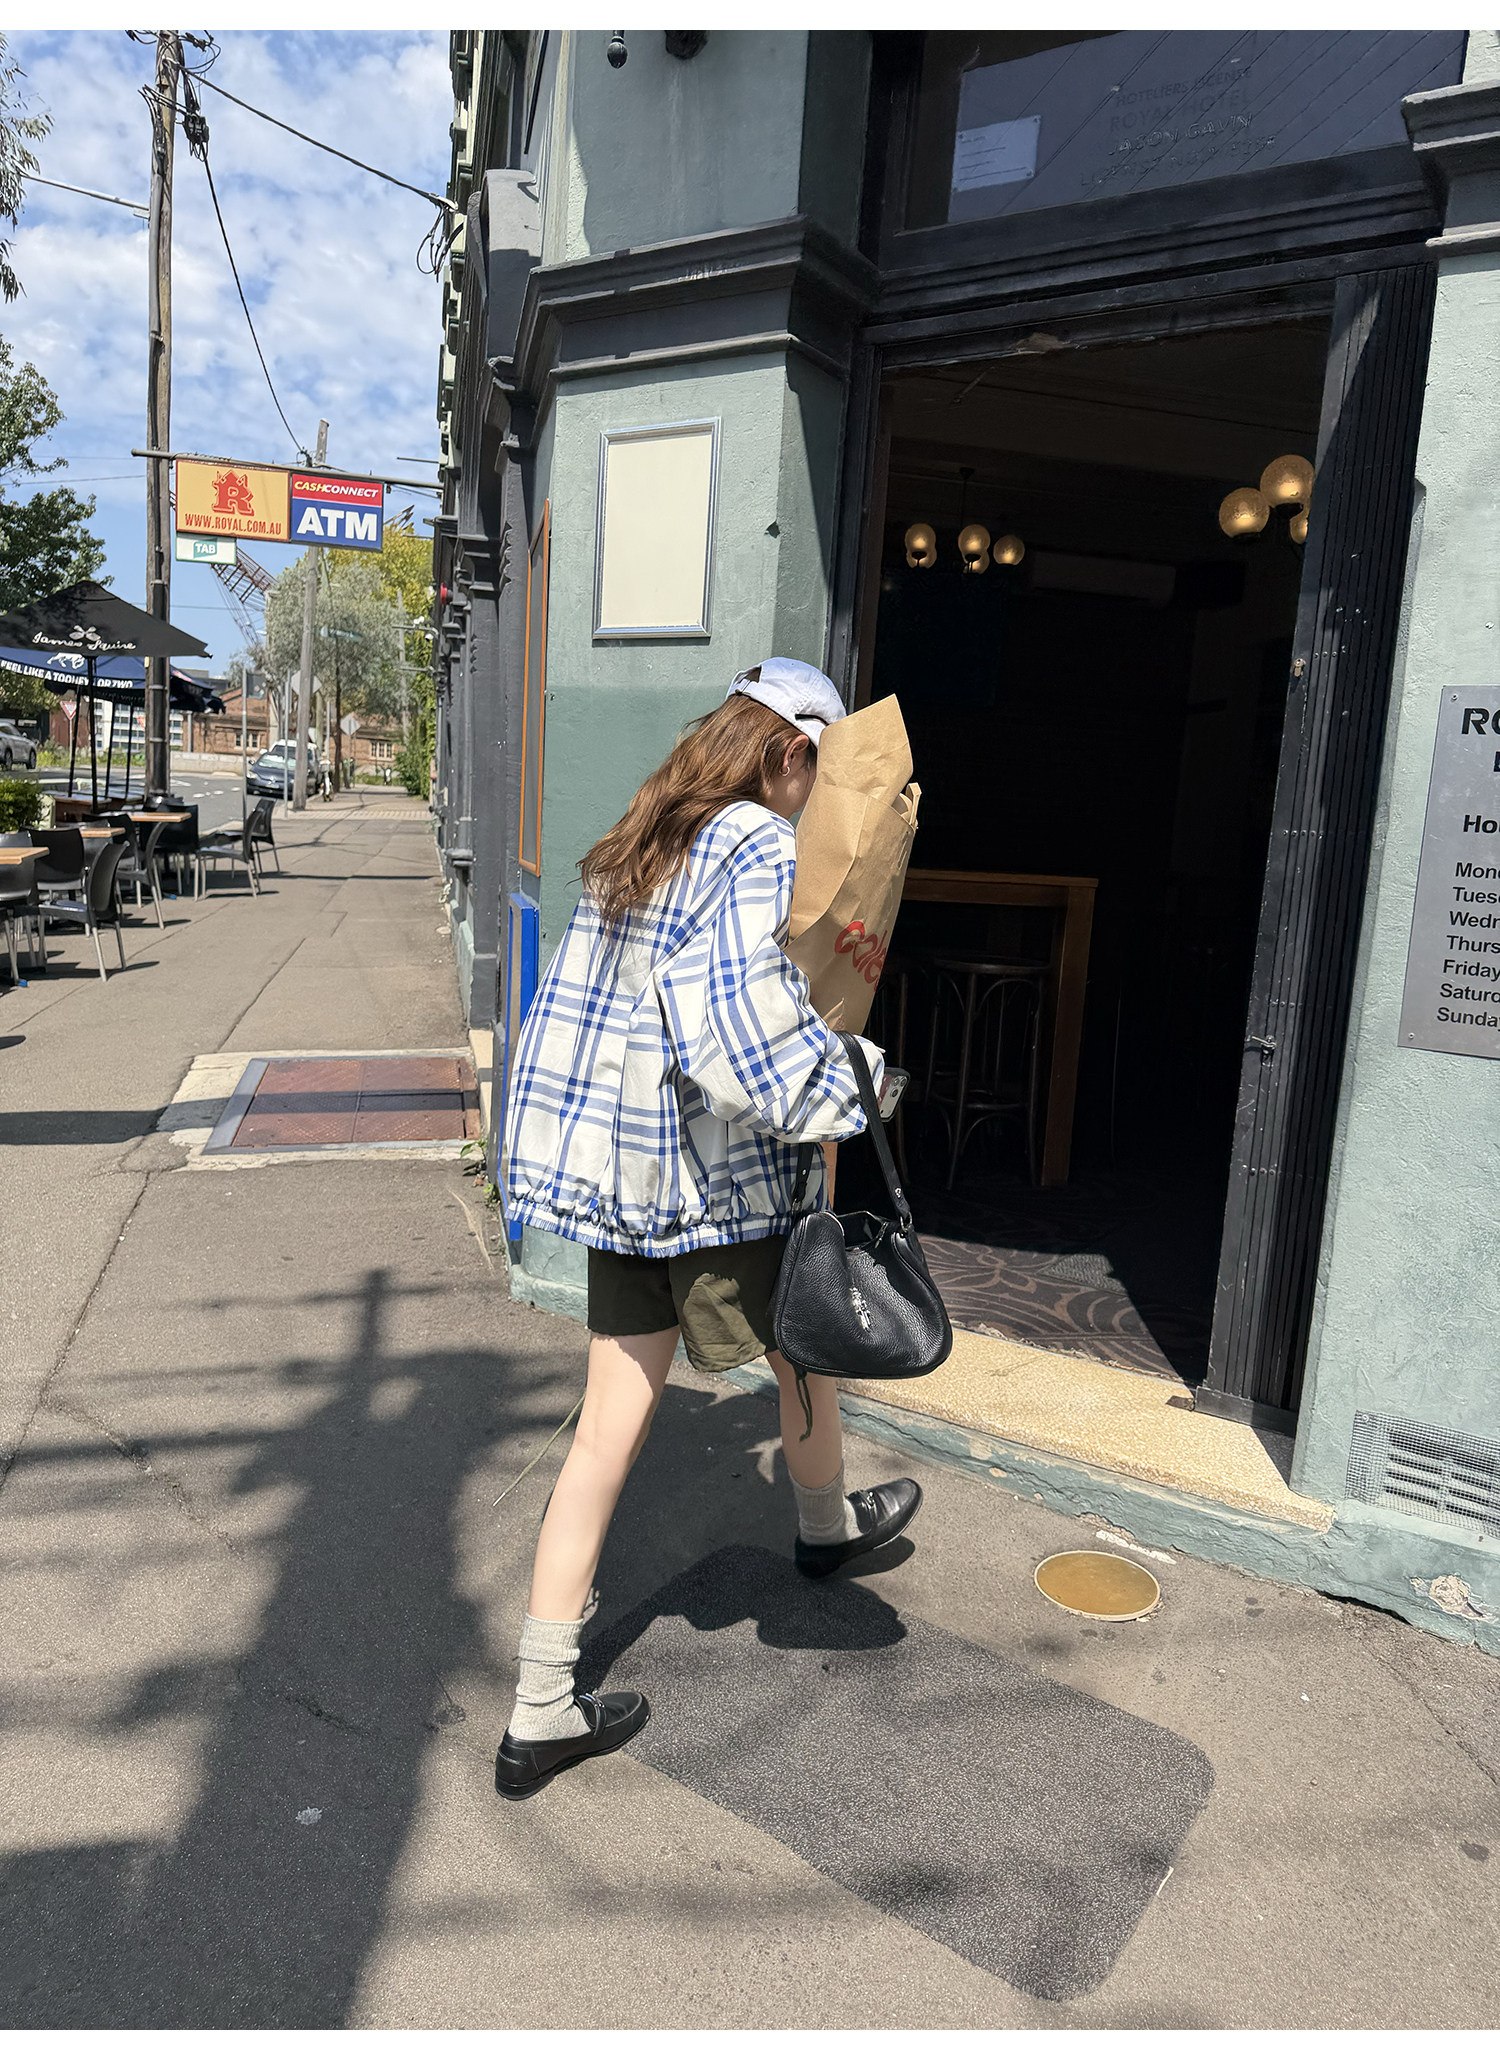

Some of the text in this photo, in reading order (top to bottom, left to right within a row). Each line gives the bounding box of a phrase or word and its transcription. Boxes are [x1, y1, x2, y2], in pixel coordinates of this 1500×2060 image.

[185, 512, 282, 536] WWW.ROYAL.COM.AU
[296, 506, 378, 542] ATM
[195, 543, 216, 554] TAB
[32, 631, 137, 652] James Squire
[0, 660, 23, 674] FEEL
[23, 663, 44, 678] LIKE
[45, 671, 52, 680] A
[1442, 959, 1500, 983] Friday
